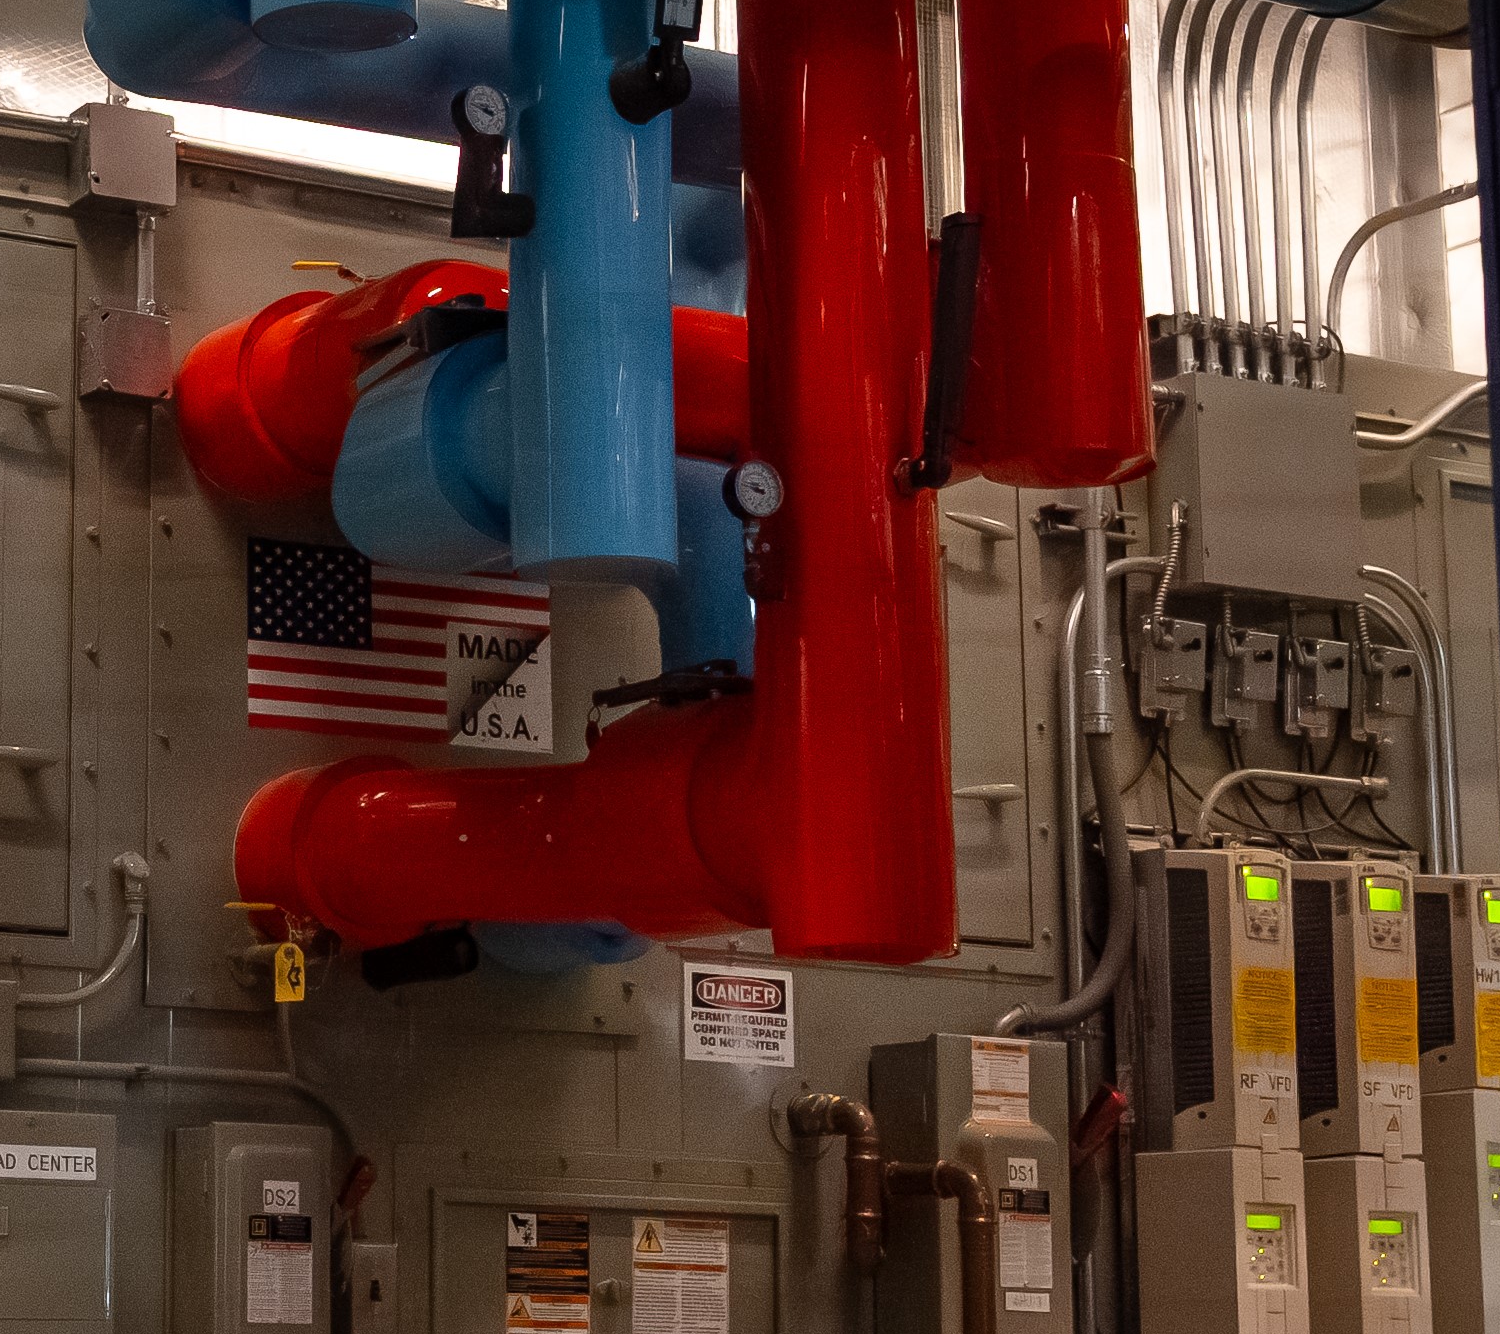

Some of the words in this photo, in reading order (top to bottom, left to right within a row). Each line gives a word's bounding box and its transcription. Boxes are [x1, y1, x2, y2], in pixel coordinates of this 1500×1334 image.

[458, 633, 538, 664] MADE
[460, 711, 538, 741] U.S.A.
[1476, 968, 1500, 984] HW1
[703, 982, 776, 1004] DANGER
[700, 1036, 716, 1046] DO
[751, 1028, 786, 1040] SPACE
[1240, 1073, 1259, 1089] RF
[1268, 1075, 1291, 1092] VFD
[1363, 1081, 1381, 1097] SF
[1391, 1083, 1413, 1100] VFD
[27, 1154, 95, 1173] CENTER
[1009, 1164, 1034, 1182] DS1
[264, 1188, 297, 1207] DS2
